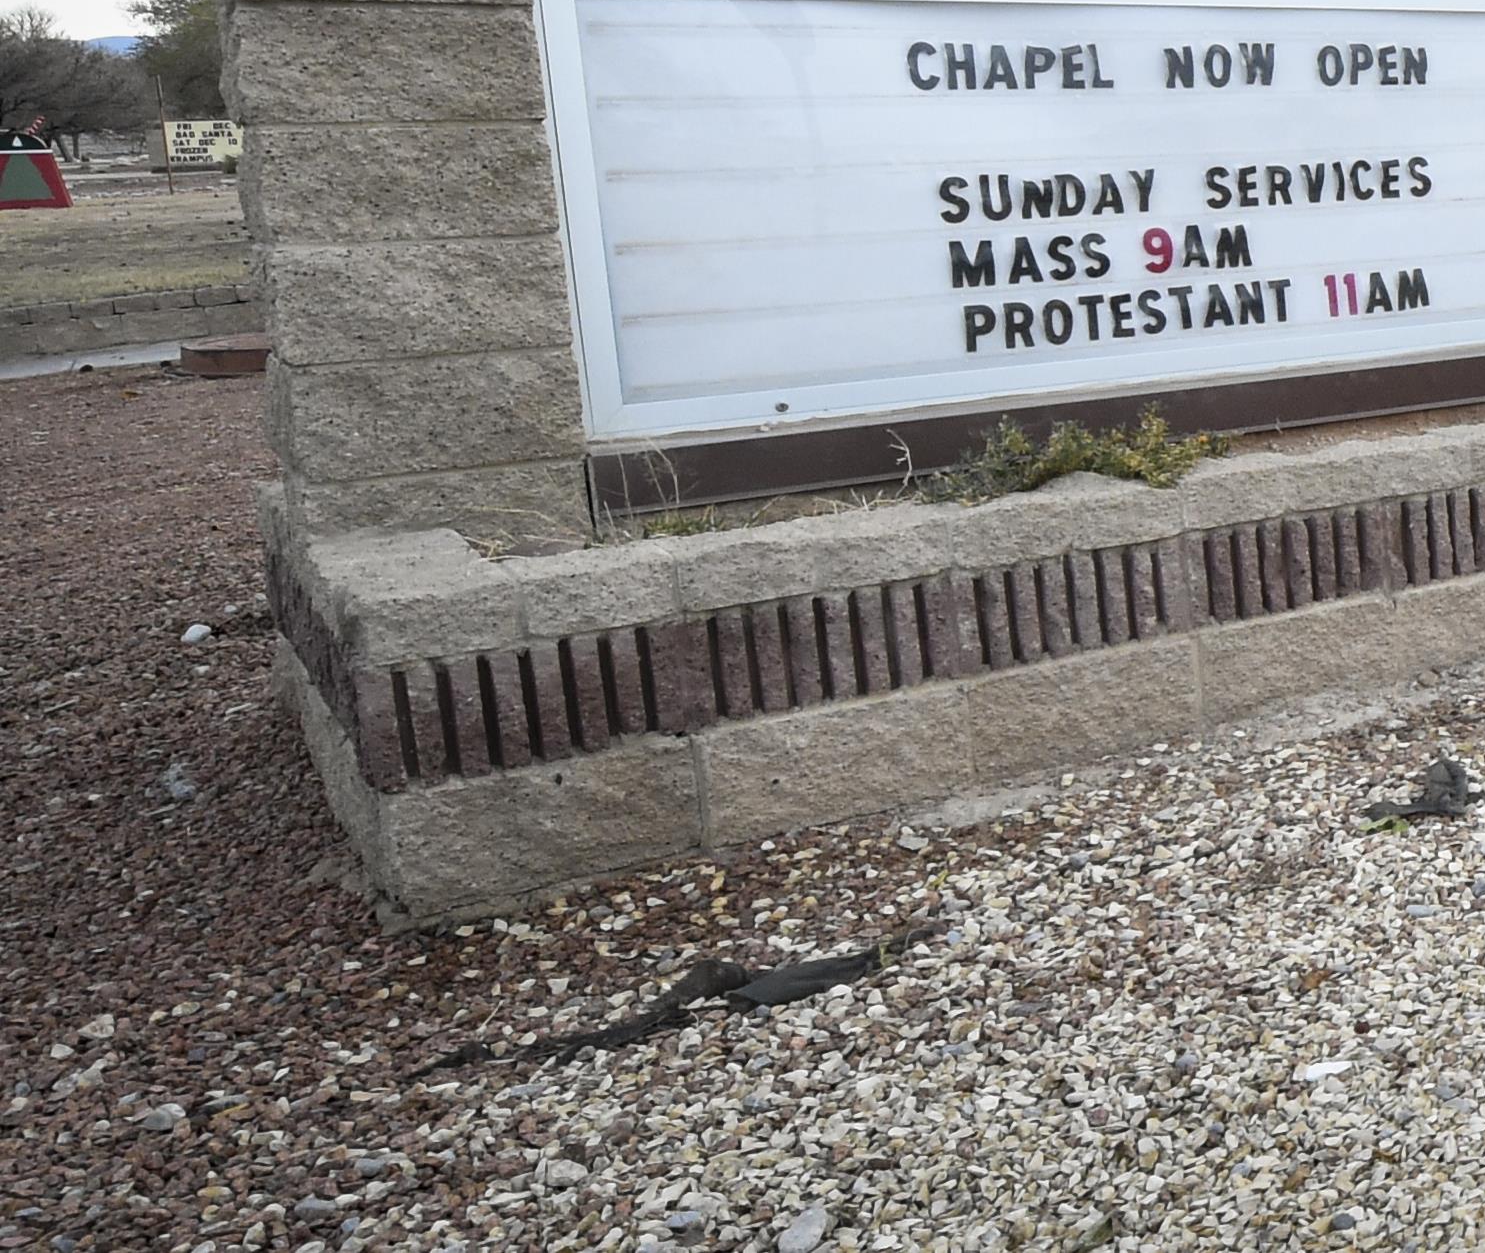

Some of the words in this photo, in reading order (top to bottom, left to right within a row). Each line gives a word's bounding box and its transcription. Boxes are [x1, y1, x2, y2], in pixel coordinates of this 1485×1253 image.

[907, 42, 1114, 90] CHAPEL
[1164, 43, 1274, 88] NOW
[1317, 44, 1427, 86] OPEN
[201, 130, 233, 138] SANTA
[213, 122, 231, 130] DEC
[170, 155, 214, 163] KRAMPUS
[939, 169, 1154, 223] SUNDAY
[1206, 157, 1431, 209] SERVICES
[949, 233, 1110, 288] MASS
[1143, 225, 1252, 273] 9AM
[963, 278, 1290, 352] PROTESTANT
[1324, 269, 1429, 316] 11AM
